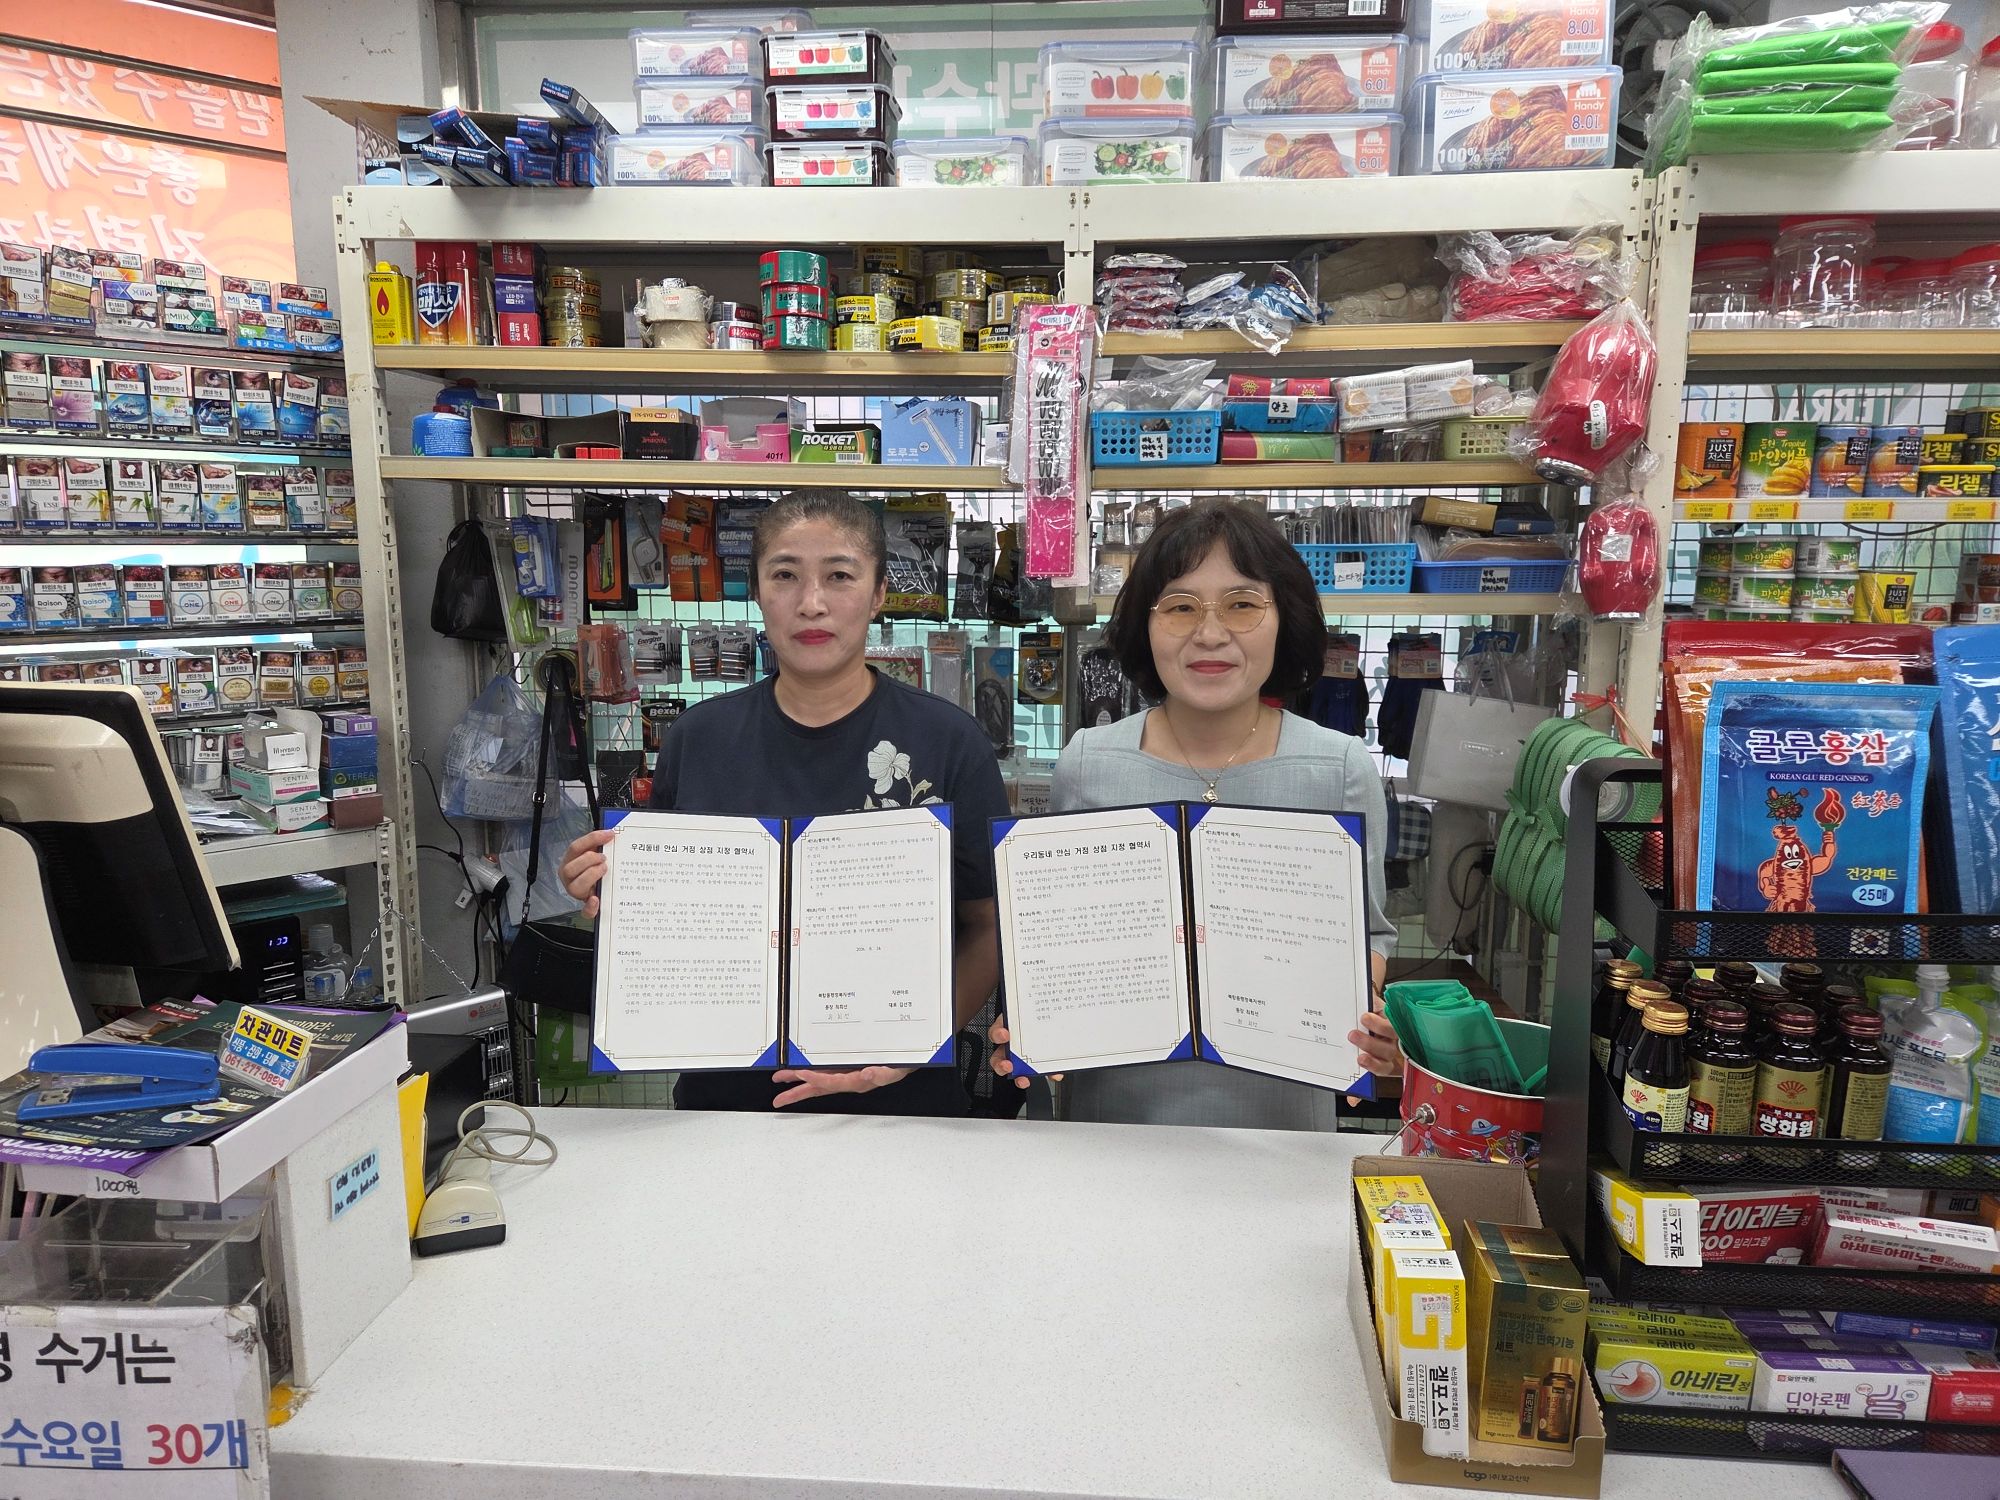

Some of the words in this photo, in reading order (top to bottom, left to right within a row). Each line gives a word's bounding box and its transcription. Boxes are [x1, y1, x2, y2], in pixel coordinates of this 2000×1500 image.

[1569, 6, 1601, 17] Handy
[1434, 52, 1478, 70] 100%
[1573, 101, 1605, 112] Handy
[1438, 147, 1481, 164] 100%
[616, 170, 637, 180] 100%
[23, 293, 40, 301] ESSE
[901, 336, 917, 344] 100M
[1271, 401, 1290, 414] 양초
[801, 433, 855, 446] ROCKET
[1708, 442, 1733, 452] JUST
[765, 452, 784, 460] 4011
[1748, 447, 1809, 469] 파인애플
[1938, 474, 1980, 493] 리챔
[661, 517, 692, 534] Gillette
[718, 531, 753, 541] Gillette
[670, 554, 708, 566] Gillette
[637, 635, 664, 645] Energizer
[690, 634, 718, 645] Energizer
[722, 635, 748, 645] Energizer
[281, 774, 309, 783] SENTIA
[1769, 772, 1801, 782] KOREAN
[1819, 774, 1836, 783] RED
[1836, 773, 1870, 784] GINSENG
[290, 804, 318, 813] SENTIA
[631, 843, 660, 852] 우리동네
[663, 844, 678, 853] 안심
[681, 845, 696, 853] 거점
[716, 846, 731, 855] 지정
[1023, 850, 1053, 859] 우리동네
[1056, 848, 1071, 857] 안심
[1074, 846, 1089, 855] 거점
[1092, 845, 1107, 854] 상점
[1111, 843, 1126, 852] 지정
[1846, 866, 1899, 881] 건강패드
[1858, 887, 1888, 902] 25매
[238, 1013, 305, 1057] 차관마트
[224, 1053, 286, 1090] 061-277-0894
[1758, 1112, 1815, 1138] 쌍화원
[95, 1176, 141, 1195] 1000원
[1699, 1203, 1802, 1231] 타이레놀
[1669, 1217, 1685, 1260] 겔포스
[1839, 1240, 1945, 1264] 아세트아미노펜
[35, 1332, 176, 1385] 수거는
[1406, 1364, 1415, 1382] 속쓰림
[1418, 1364, 1426, 1397] COATING
[1670, 1369, 1738, 1392] 아네린
[1429, 1364, 1449, 1418] 겔포스
[1786, 1391, 1851, 1410] 디아로펜
[0, 1418, 124, 1469] 수요일
[146, 1418, 249, 1469] 30개
